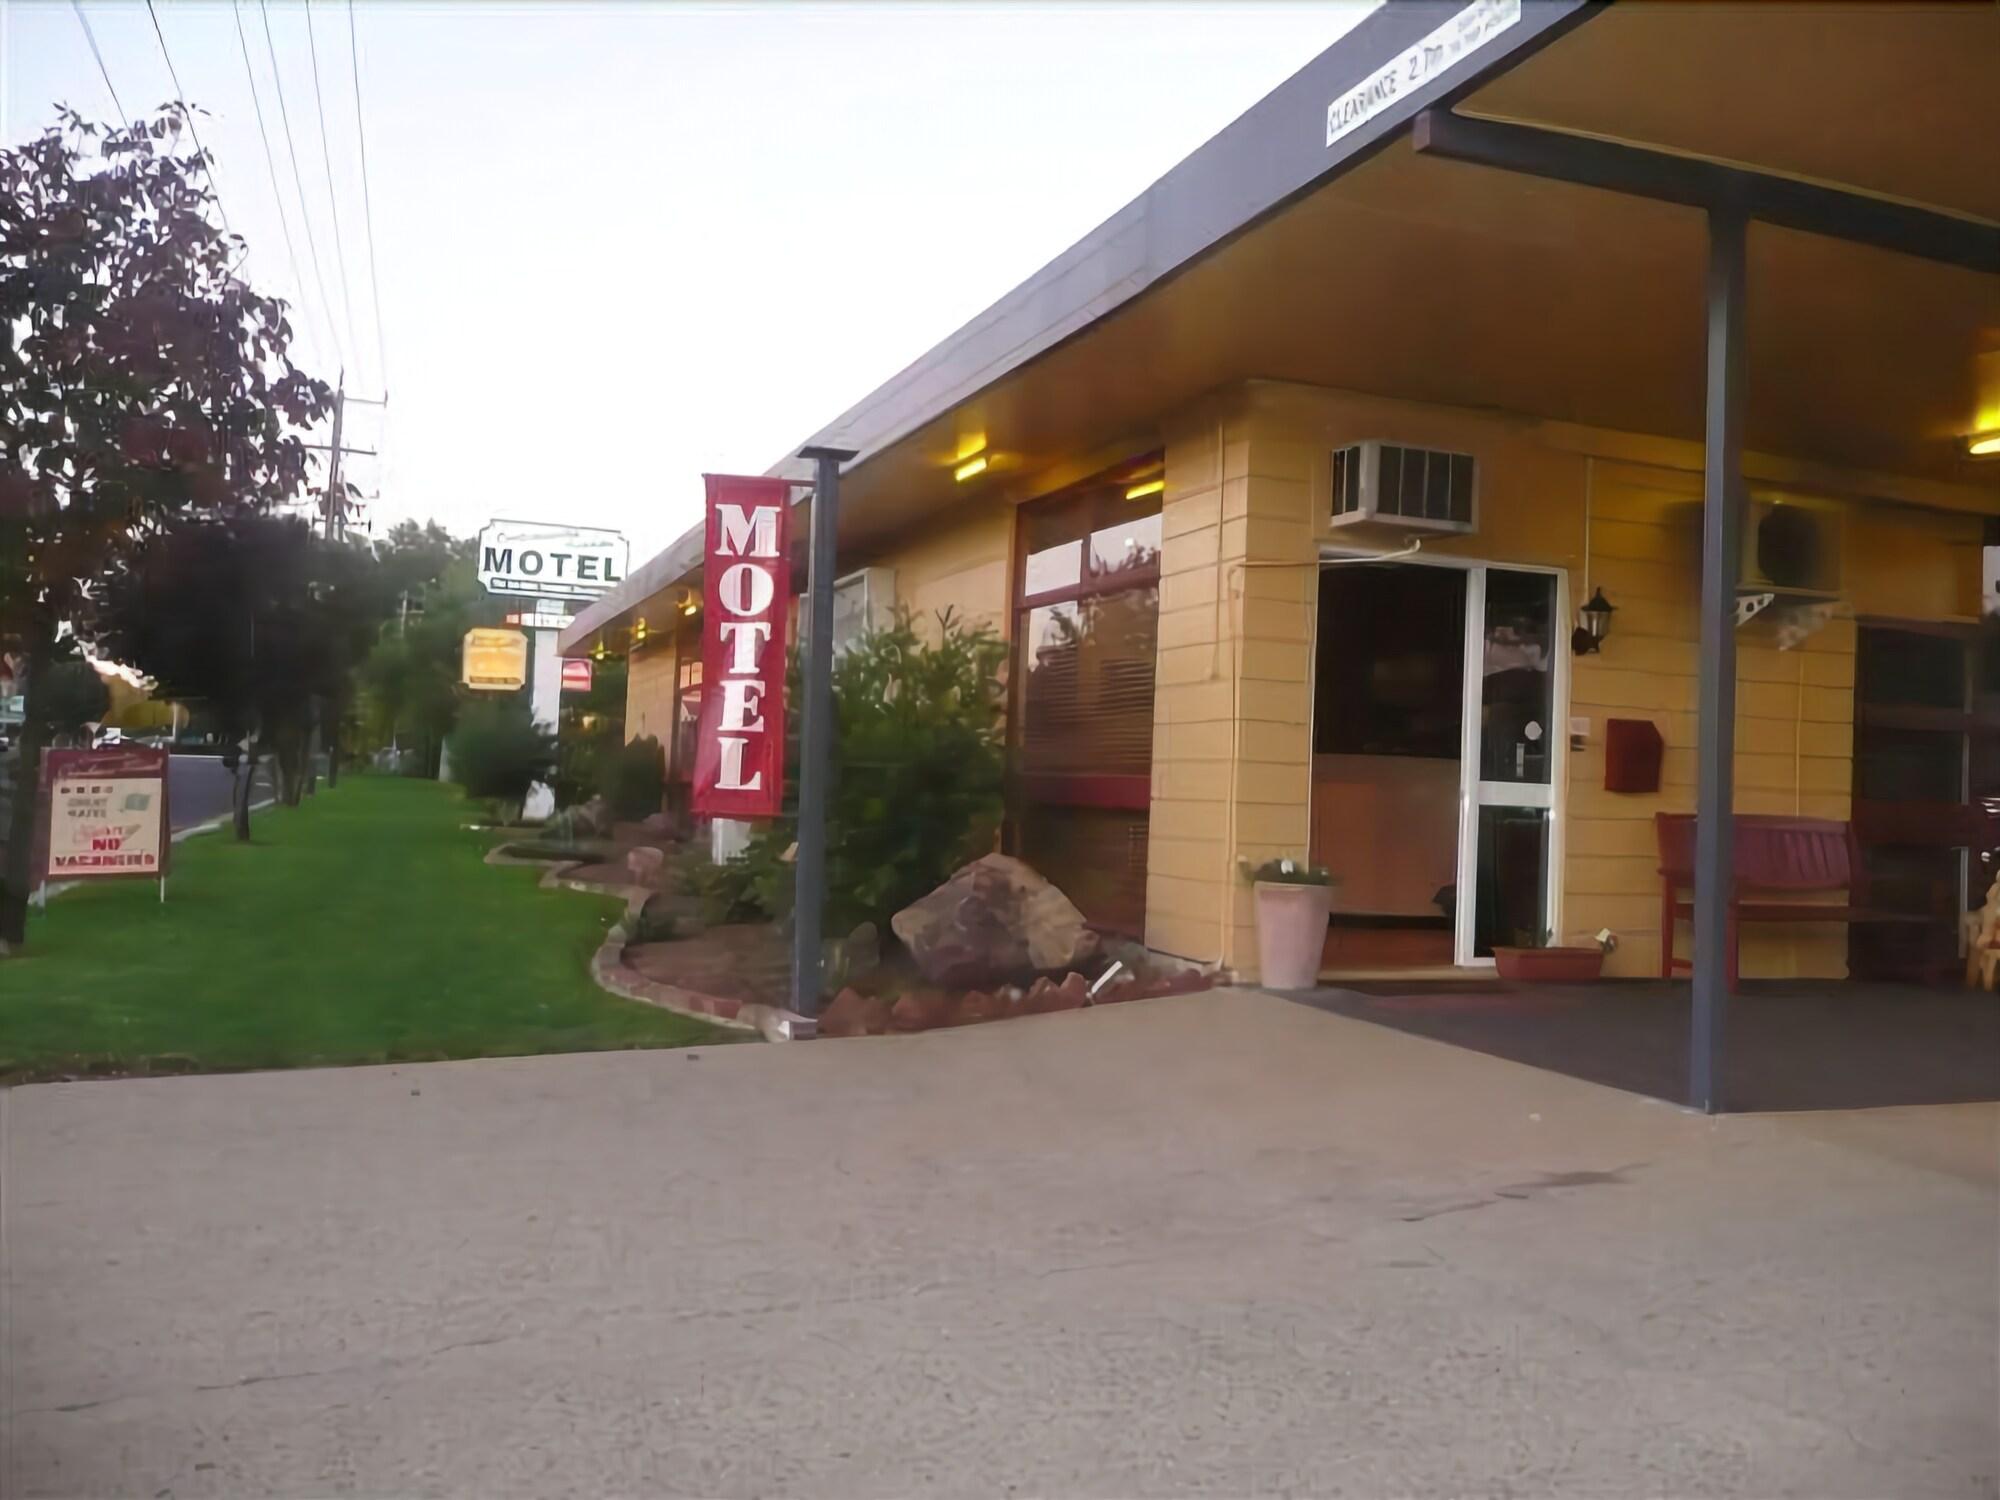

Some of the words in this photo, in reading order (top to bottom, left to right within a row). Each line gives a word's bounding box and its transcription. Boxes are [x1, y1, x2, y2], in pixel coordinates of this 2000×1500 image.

[483, 547, 622, 582] MOTEL
[714, 503, 782, 790] MOTEL
[92, 838, 121, 851] NO
